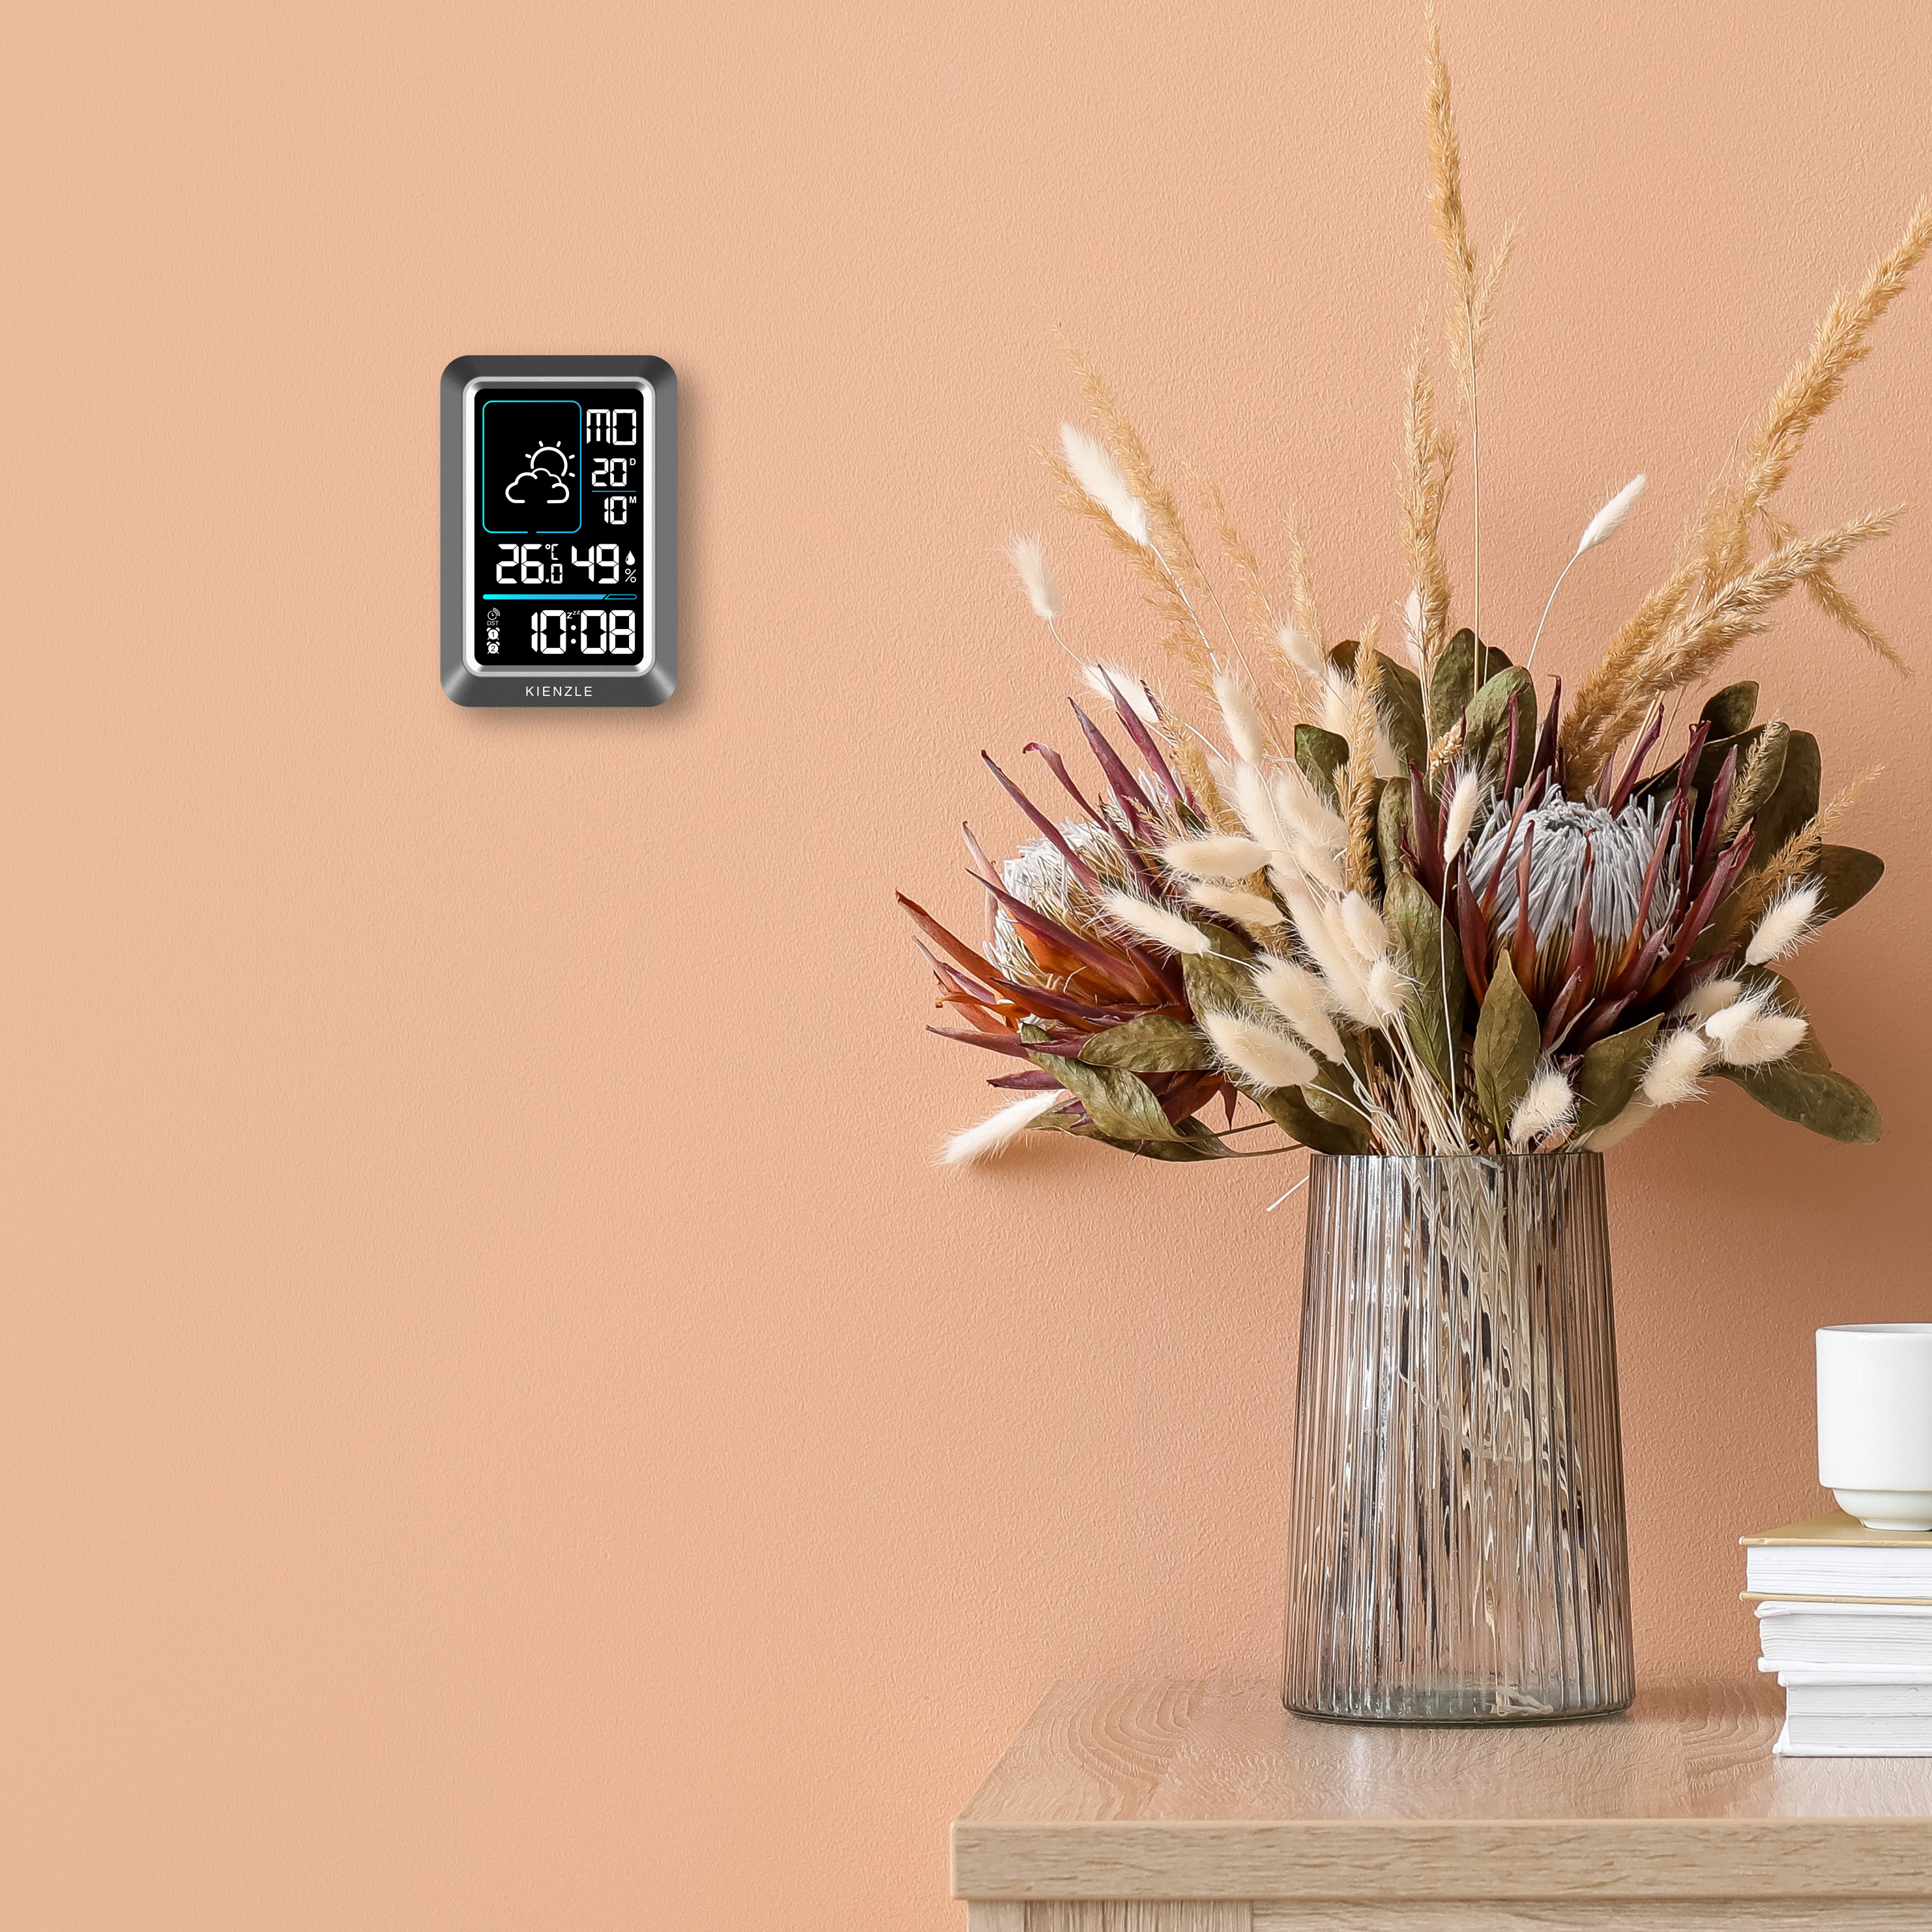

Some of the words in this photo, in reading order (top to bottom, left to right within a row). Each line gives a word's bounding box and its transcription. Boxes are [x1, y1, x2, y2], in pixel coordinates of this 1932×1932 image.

[587, 409, 636, 445] MO
[592, 458, 626, 486] 20
[604, 496, 626, 525] 10
[572, 544, 619, 584] 49
[531, 609, 636, 654] 10:08
[525, 686, 593, 697] KIENZLE
